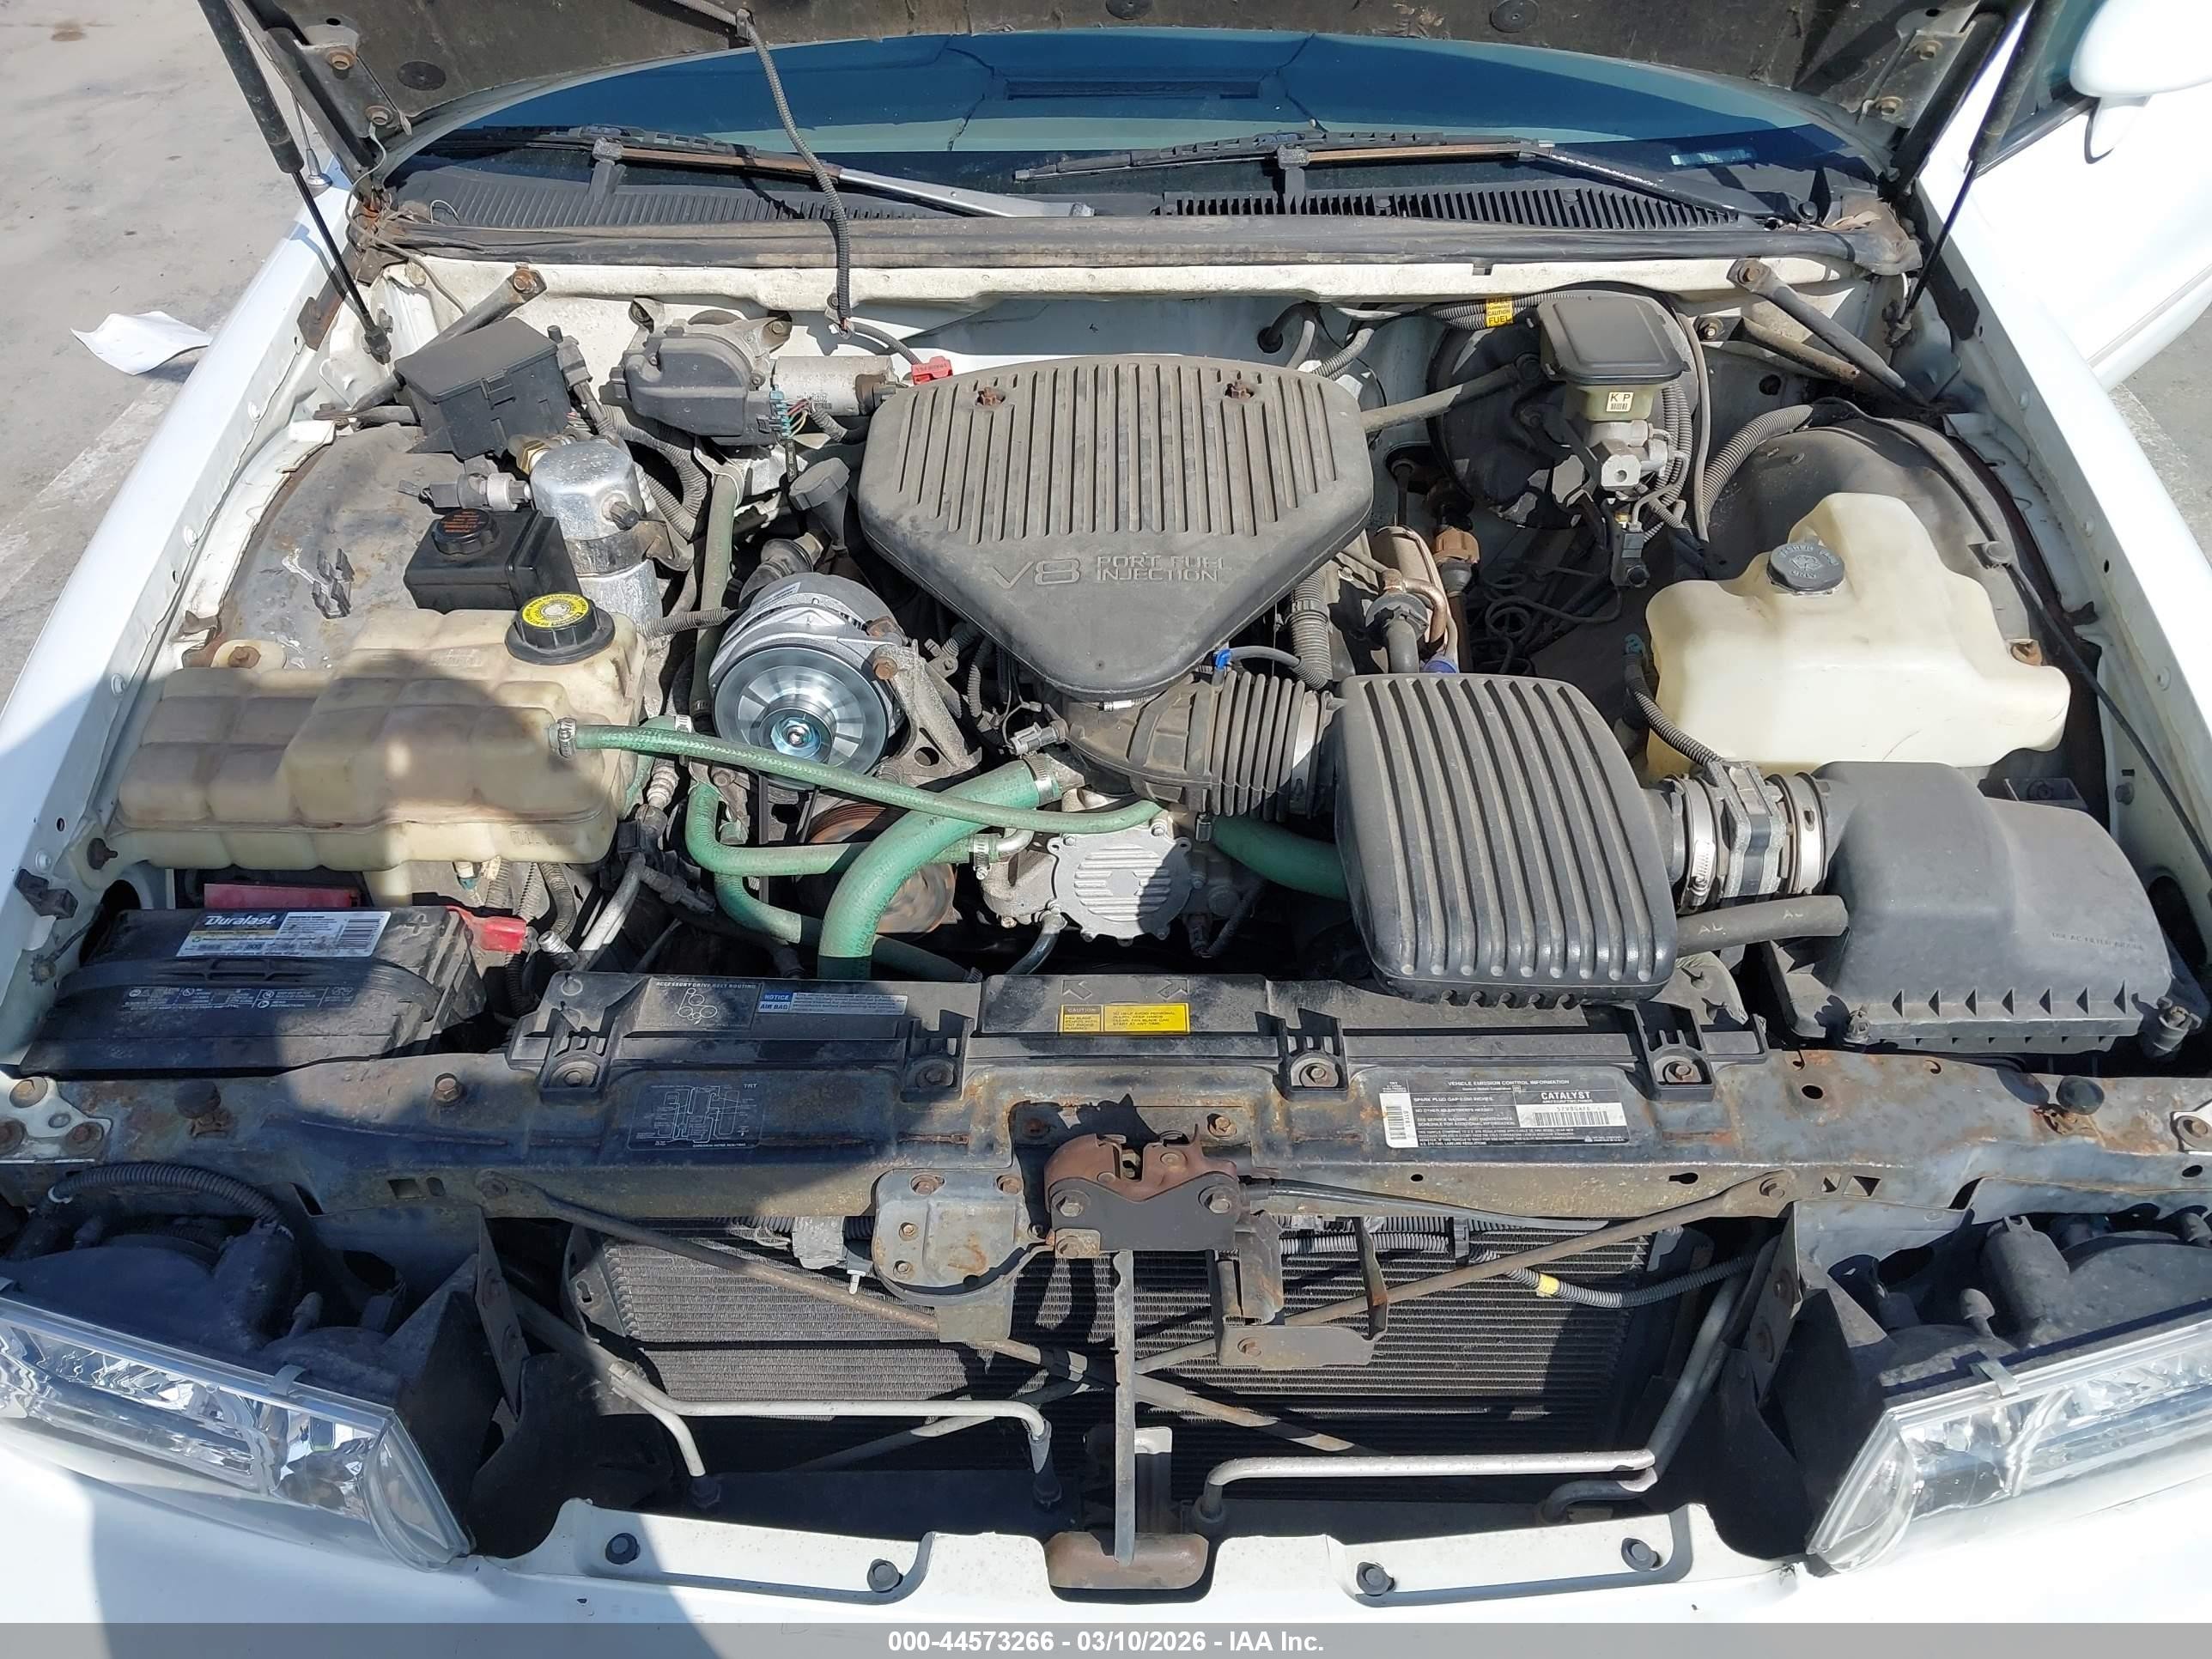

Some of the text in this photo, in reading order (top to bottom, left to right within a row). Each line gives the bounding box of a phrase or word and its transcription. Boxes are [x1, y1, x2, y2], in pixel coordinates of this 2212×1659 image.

[1488, 315, 1511, 324] FUEL
[1097, 555, 1224, 569] PORT FUEL
[990, 558, 1081, 590] V8
[1097, 568, 1219, 583] INJECTION
[204, 915, 277, 926] Duralast
[1540, 1091, 1591, 1100] CATALYST
